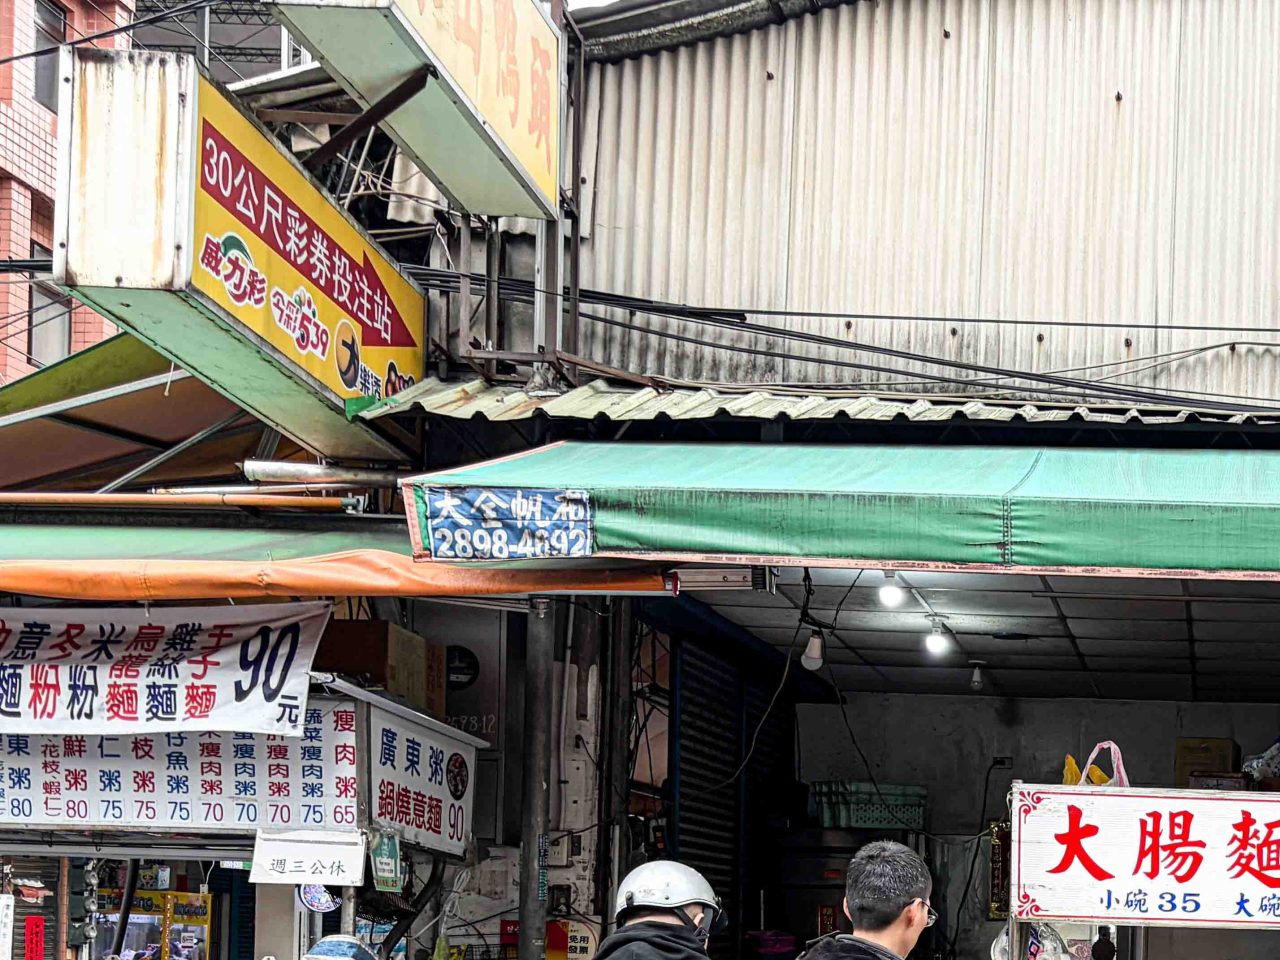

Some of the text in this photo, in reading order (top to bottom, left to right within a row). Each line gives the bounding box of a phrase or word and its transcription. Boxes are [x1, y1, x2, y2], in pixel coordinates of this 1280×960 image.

[204, 136, 393, 345] 30公尺彩券投注站
[201, 237, 266, 305] 威力彩
[271, 290, 330, 358] 今彩539
[234, 622, 300, 724] 90 元
[333, 710, 357, 824] 瘦肉粥 65
[379, 727, 444, 787] 廣東粥
[10, 798, 32, 818] 80
[66, 800, 88, 819] 80
[101, 800, 123, 820] 75
[134, 800, 156, 820] 75
[167, 801, 190, 821] 75
[202, 803, 224, 822] 70
[235, 803, 257, 822] 70
[269, 804, 291, 823] 70
[302, 805, 323, 824] 75
[377, 779, 464, 842] 鍋燒意麵 90
[269, 858, 347, 876] 週三公休
[1100, 888, 1149, 913] 小碗
[1158, 891, 1200, 913] 35
